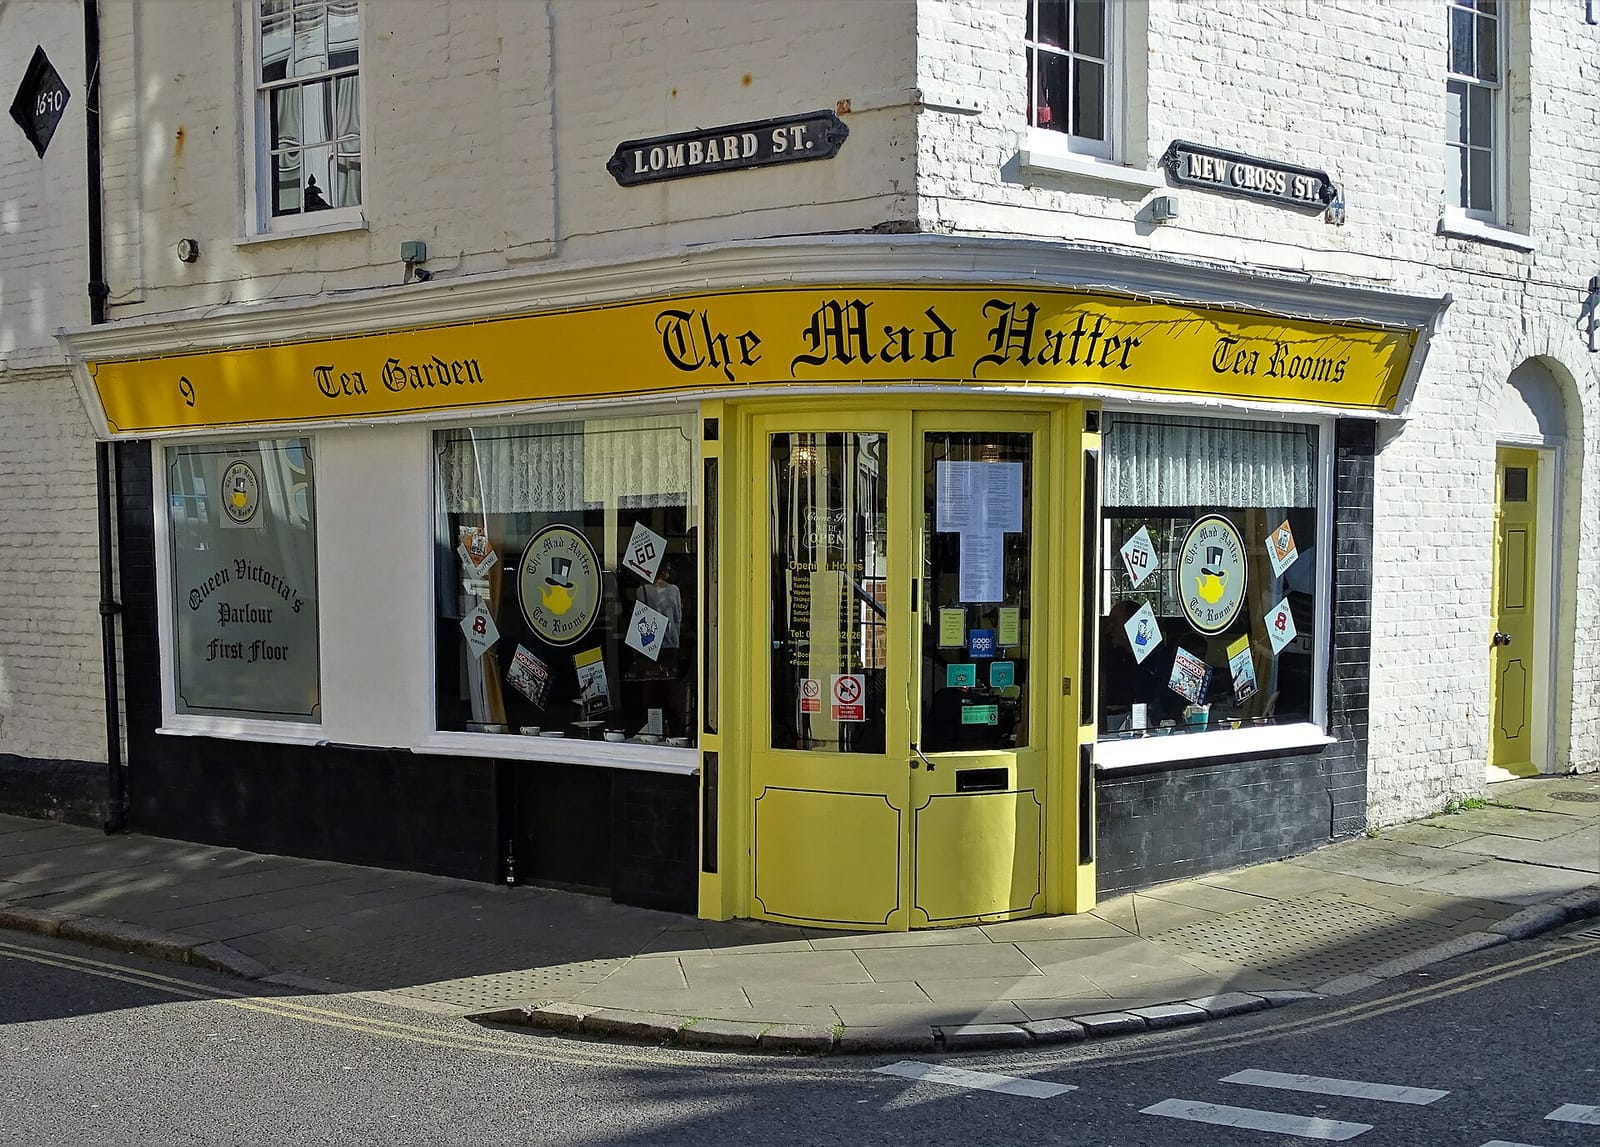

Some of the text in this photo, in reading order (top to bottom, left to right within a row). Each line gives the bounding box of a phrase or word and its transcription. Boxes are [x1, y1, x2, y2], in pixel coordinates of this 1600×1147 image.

[36, 90, 63, 116] 1690
[634, 125, 814, 174] LOMBARD ST.
[1189, 154, 1321, 201] NEW CROSS ST.
[655, 298, 1144, 382] The Mad Hatter
[1211, 336, 1351, 384] Tea Rooms
[179, 375, 196, 408] 9
[313, 355, 485, 399] Tea Garden
[809, 531, 845, 545] OPEN
[1185, 526, 1239, 565] The Mad Hatter
[526, 537, 590, 576] The Mad Hatter
[634, 542, 656, 565] GO
[789, 560, 864, 572] Openi Hors
[1132, 548, 1148, 569] GO
[188, 558, 304, 613] Queen Victoria's
[217, 602, 273, 627] Parlour
[533, 606, 586, 636] Tea Rooms
[1189, 597, 1235, 625] Tea Rooms
[790, 630, 804, 638] Tel:
[205, 638, 289, 664] First Floor
[515, 651, 546, 680] MONOPOLY
[1176, 655, 1203, 678] MONOPOLY
